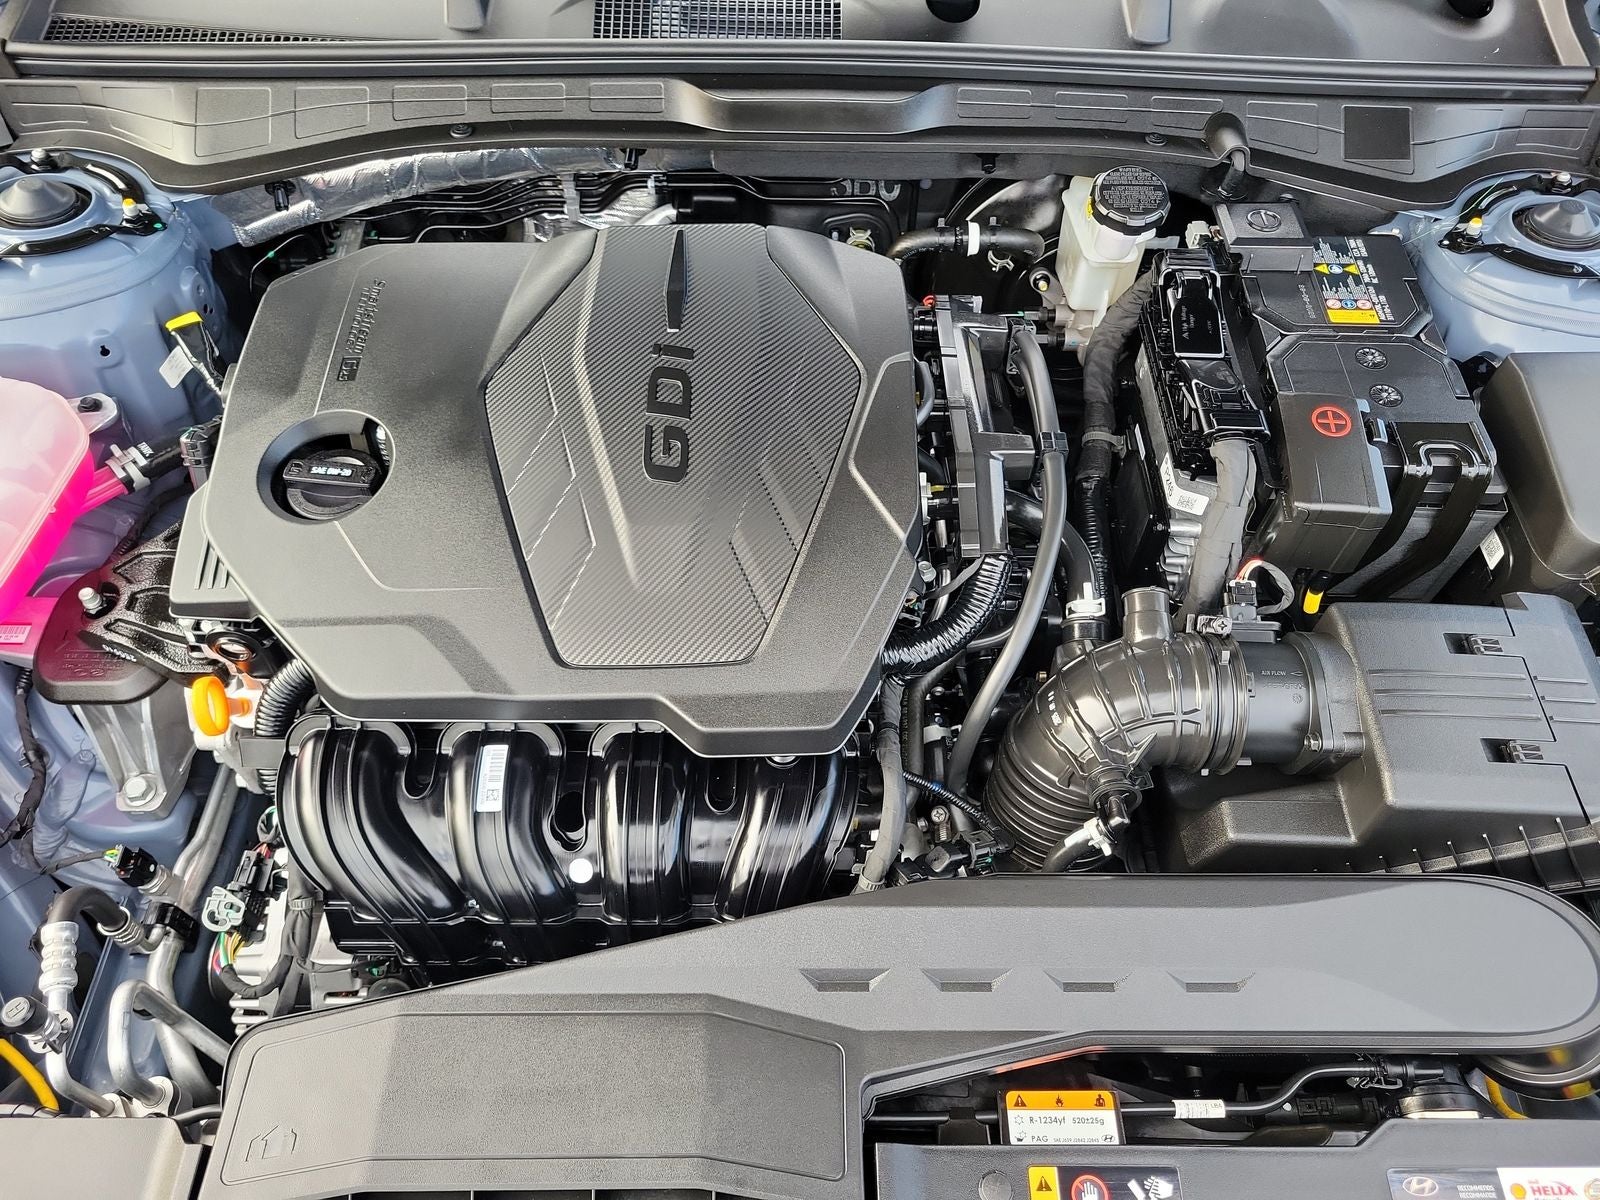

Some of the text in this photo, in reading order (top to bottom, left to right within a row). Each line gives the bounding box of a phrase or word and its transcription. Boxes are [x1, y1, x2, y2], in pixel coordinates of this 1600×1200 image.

[310, 466, 327, 475] SAE
[1029, 1116, 1105, 1126] R-1234yf 520±25g
[1031, 1135, 1048, 1143] PAG
[1530, 1185, 1576, 1197] HELIX
